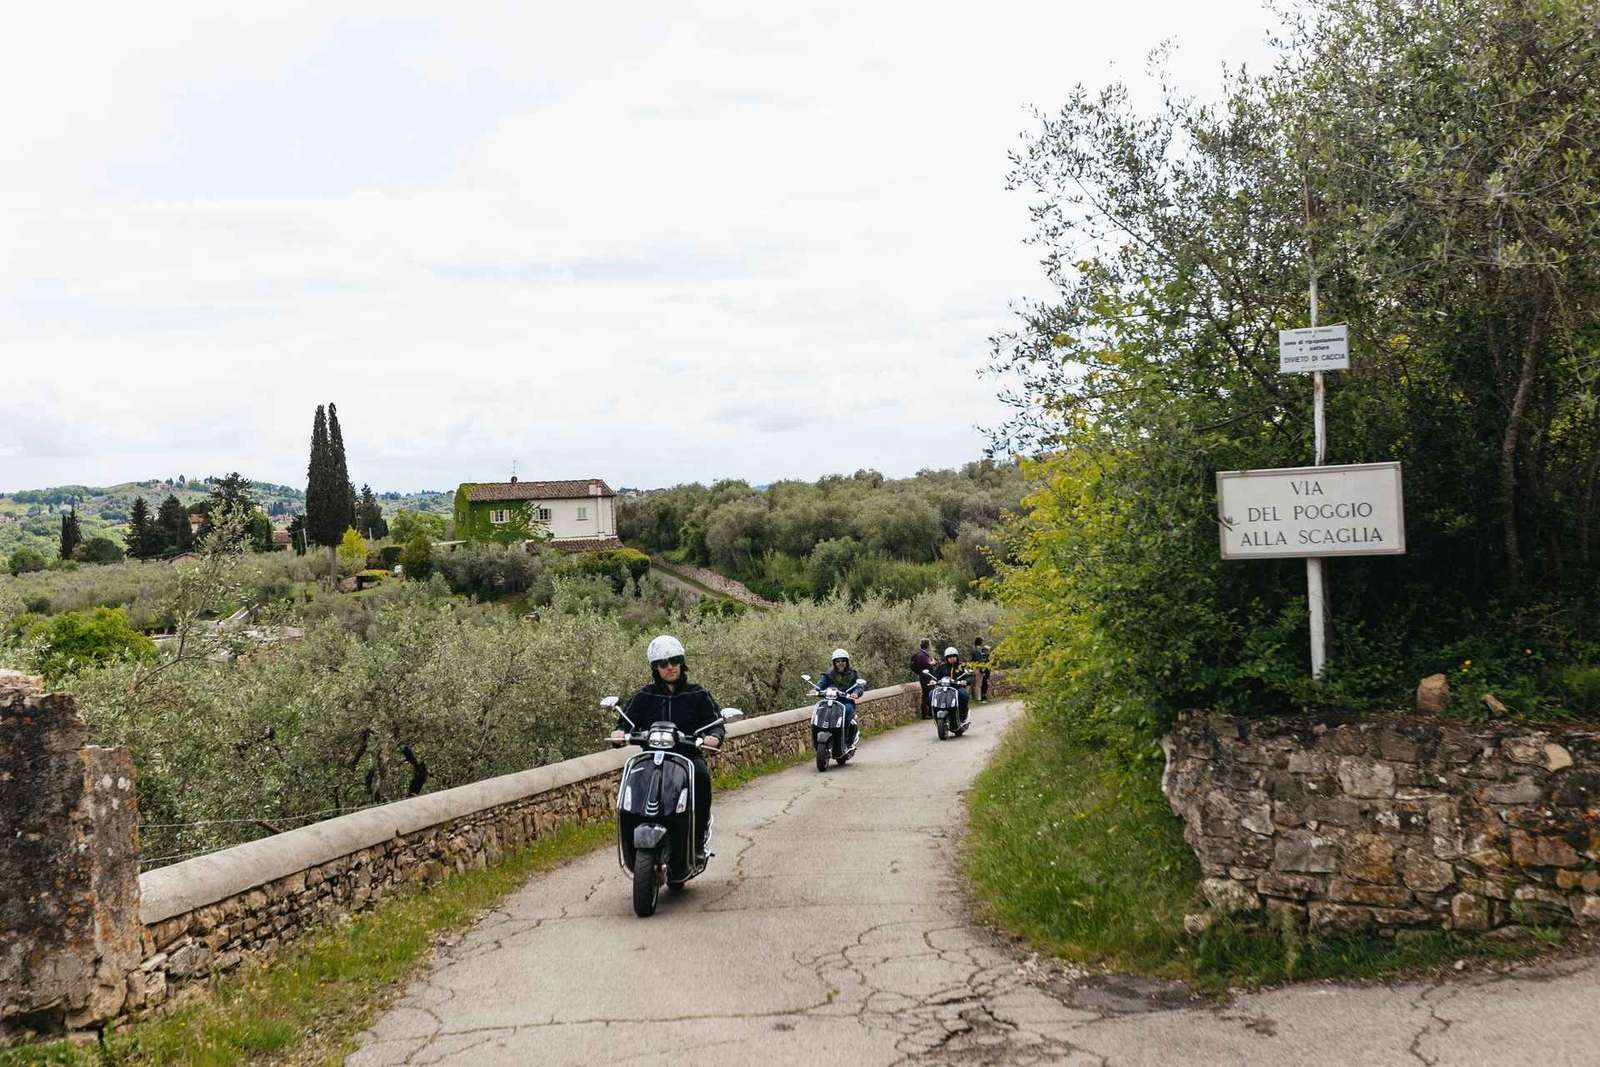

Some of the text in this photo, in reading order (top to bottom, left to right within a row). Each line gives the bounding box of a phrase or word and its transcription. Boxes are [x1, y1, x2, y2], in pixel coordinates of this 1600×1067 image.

[1284, 355, 1309, 363] DIVIETO
[1321, 353, 1345, 361] CACCIA
[1290, 480, 1324, 496] VIA
[1247, 502, 1373, 522] DEL POGGIO
[1240, 527, 1384, 547] ALLA SCAGLIA
